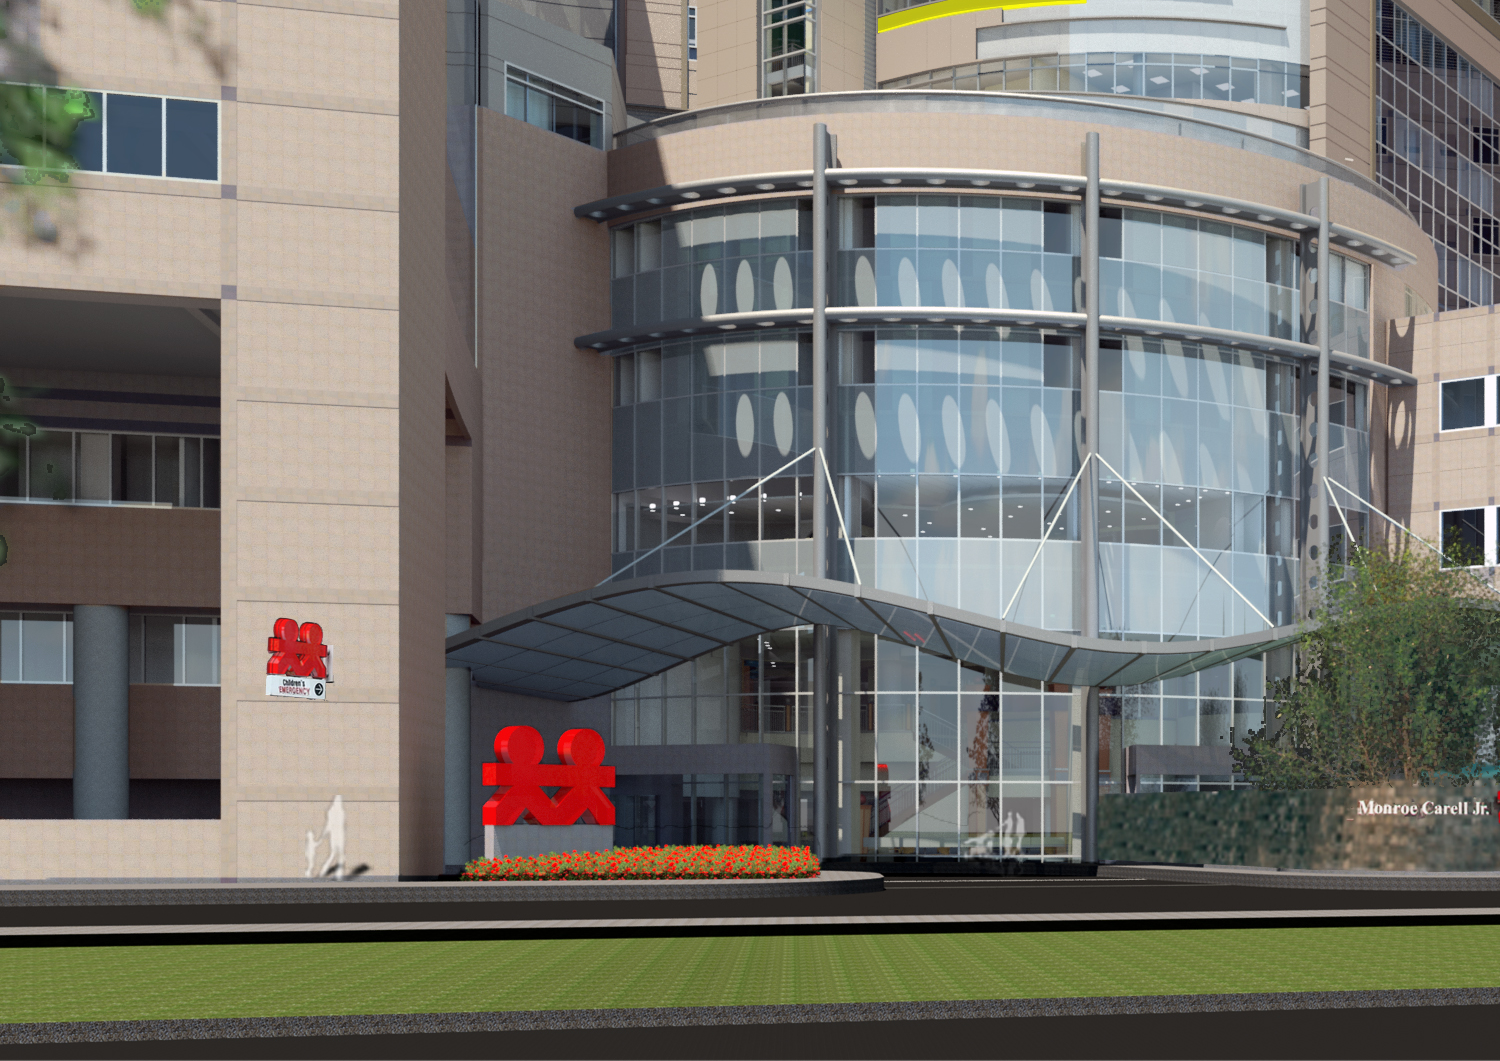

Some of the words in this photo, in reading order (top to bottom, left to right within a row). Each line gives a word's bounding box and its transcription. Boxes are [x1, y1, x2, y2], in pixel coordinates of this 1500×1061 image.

[282, 679, 306, 687] Children's
[278, 686, 311, 696] EMERGENCY
[1357, 800, 1418, 815] Monroe
[1422, 801, 1468, 815] Carell
[1472, 801, 1490, 815] Jr.
